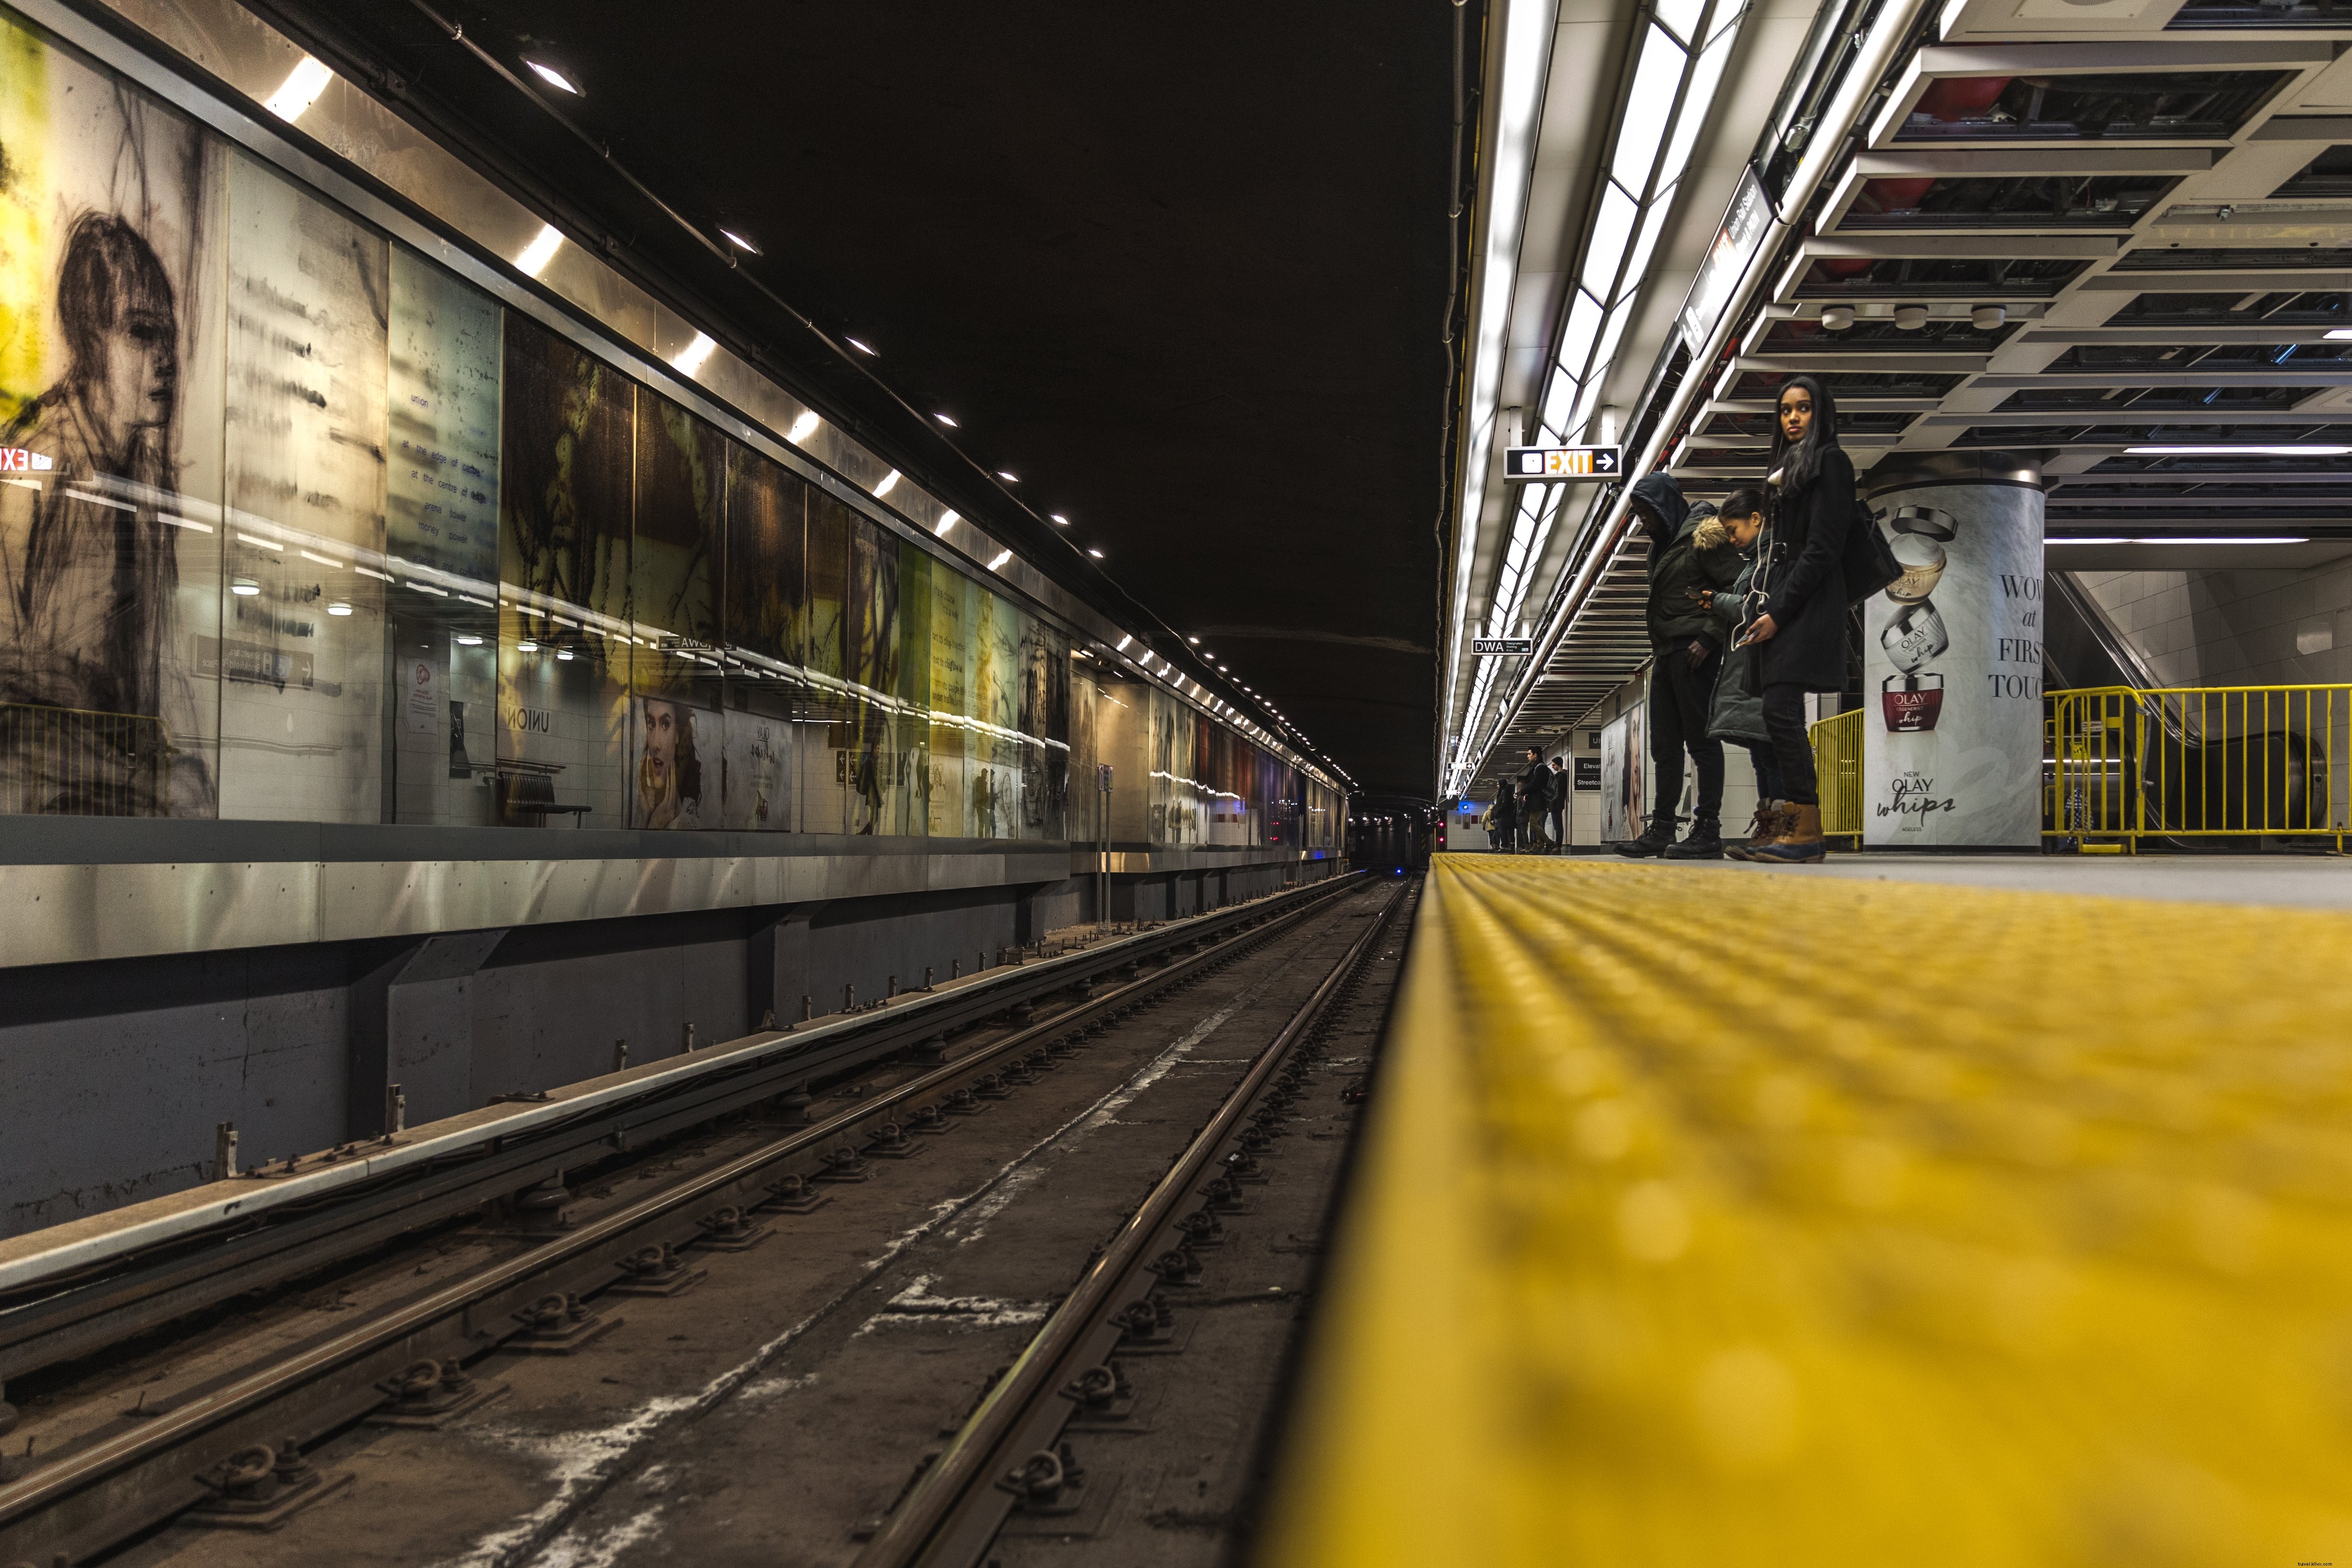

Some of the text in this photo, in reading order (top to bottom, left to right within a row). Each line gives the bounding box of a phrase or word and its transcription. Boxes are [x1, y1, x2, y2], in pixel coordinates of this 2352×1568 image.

[411, 395, 429, 407] union
[402, 440, 409, 449] at
[417, 444, 427, 455] the
[432, 452, 447, 464] edge
[452, 459, 458, 467] of
[1545, 451, 1593, 474] EXIT
[411, 469, 419, 479] at
[423, 473, 433, 484] the
[438, 480, 457, 493] centre
[462, 488, 468, 497] of
[425, 502, 466, 522] arena tower
[418, 522, 467, 544] money power
[442, 562, 454, 572] and
[1897, 576, 1920, 584] LAY
[2022, 610, 2037, 627] at
[1475, 642, 1504, 651] DWA
[1901, 626, 1925, 649] OLAY
[1911, 643, 1934, 663] whip
[1997, 638, 2043, 665] FIRS
[1894, 693, 1927, 705] OLAY
[1896, 711, 1924, 726] whip
[1892, 778, 1933, 792] OLAY
[1877, 786, 1956, 827] whips
